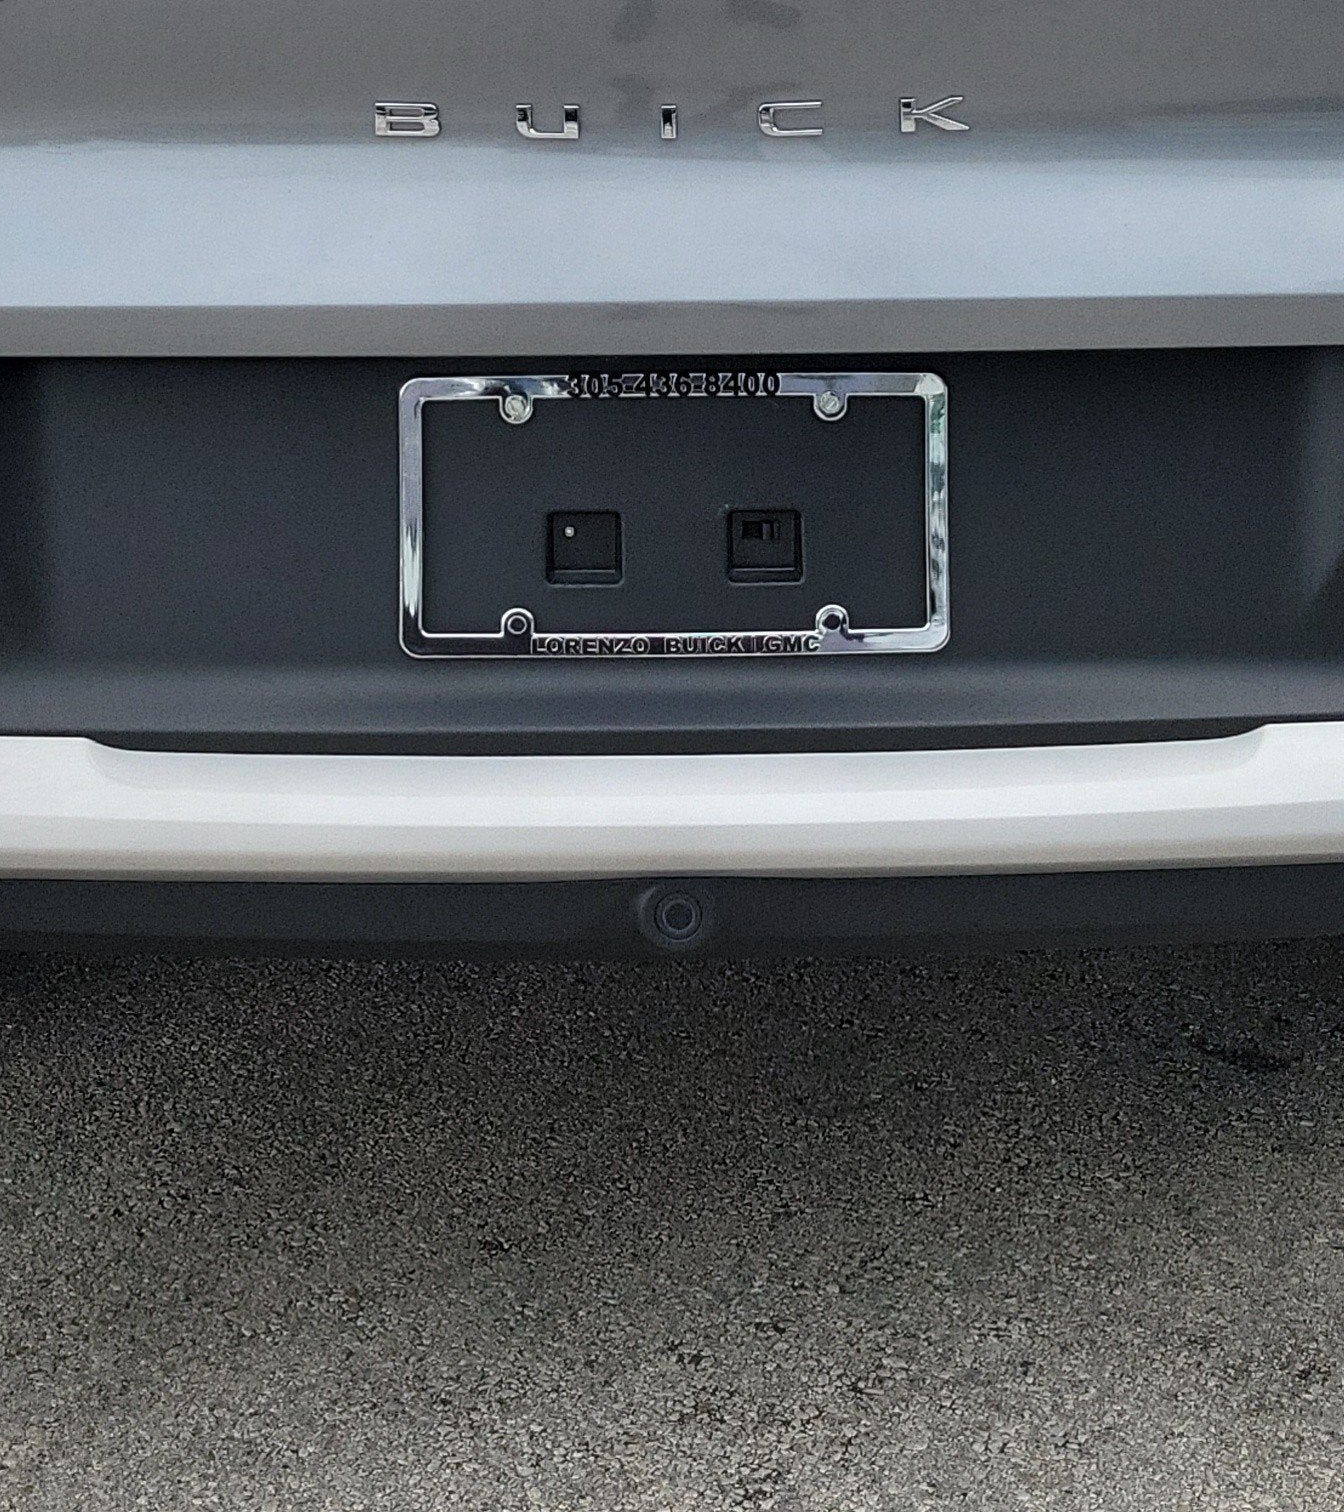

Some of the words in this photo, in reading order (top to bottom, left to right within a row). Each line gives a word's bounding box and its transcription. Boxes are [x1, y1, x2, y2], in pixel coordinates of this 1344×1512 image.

[374, 95, 971, 140] BUICK
[532, 636, 650, 654] LORENZO
[664, 635, 746, 654] BUICK
[763, 634, 822, 653] GMC
